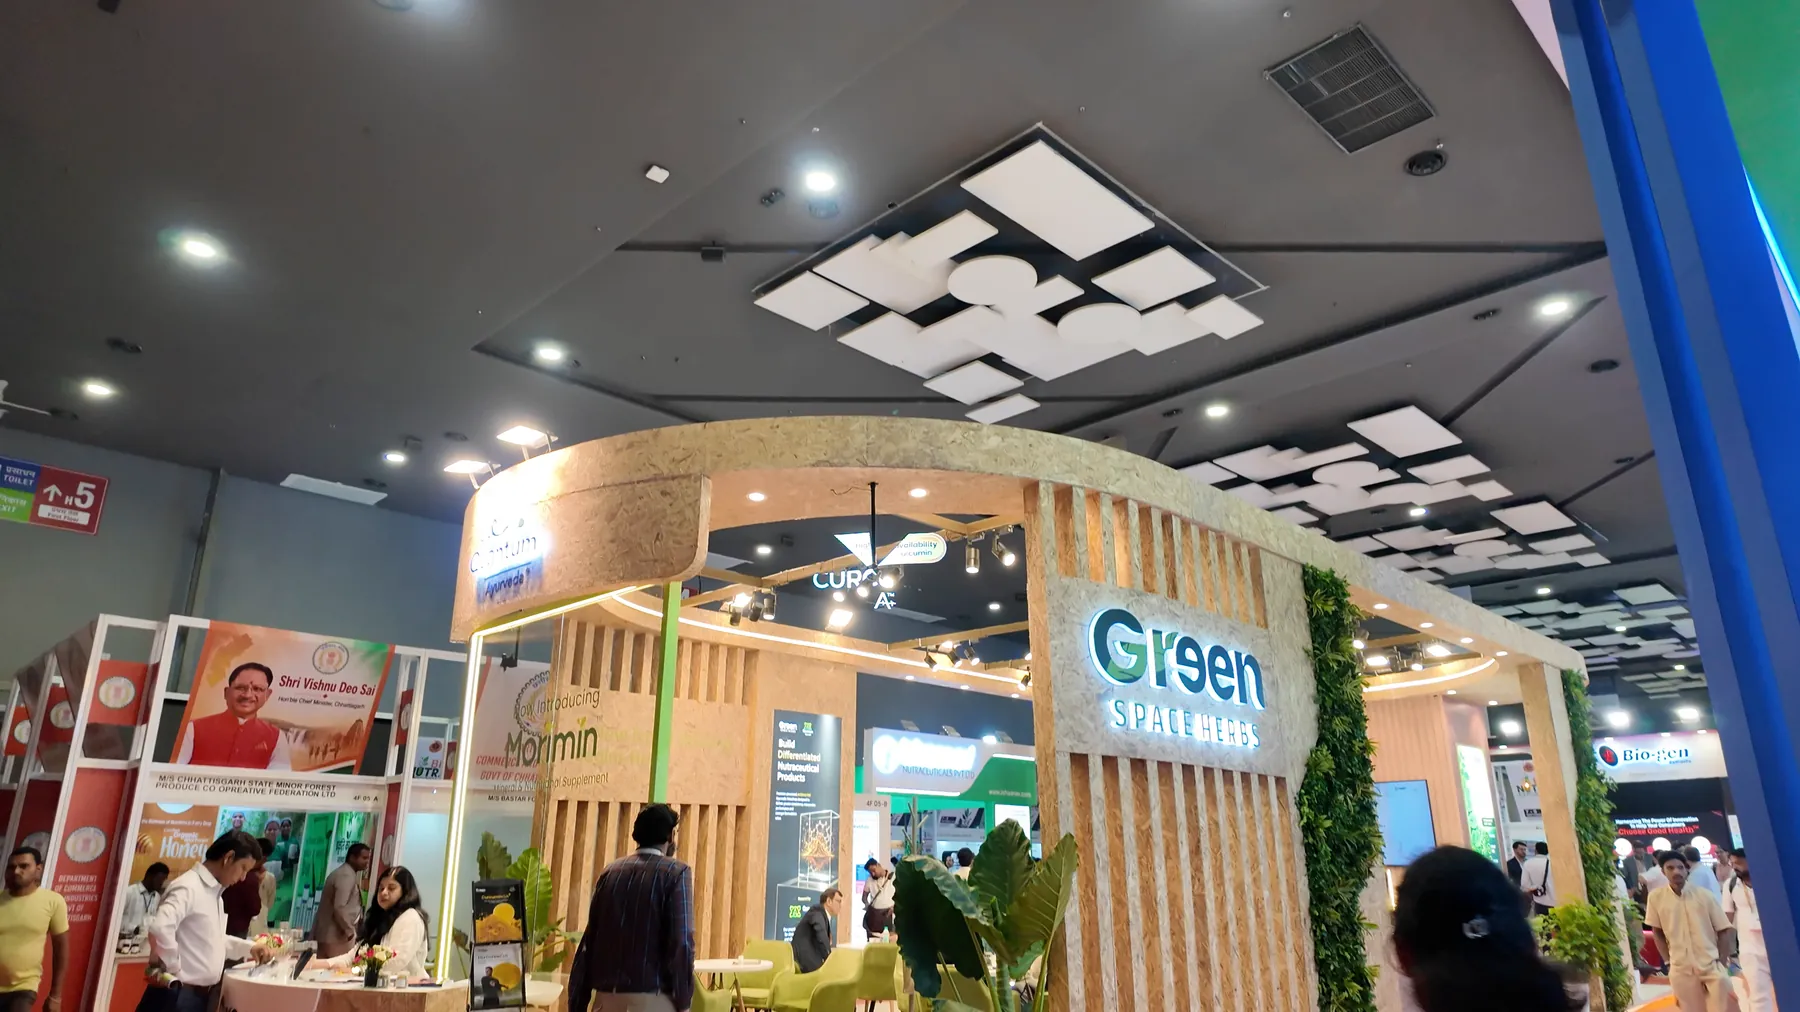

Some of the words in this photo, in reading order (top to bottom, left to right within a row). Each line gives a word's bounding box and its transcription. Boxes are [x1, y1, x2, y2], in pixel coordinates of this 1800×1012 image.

[4, 474, 34, 486] TOILET
[1089, 608, 1266, 710] Green
[279, 675, 301, 689] Shri
[303, 677, 337, 692] Vishnu
[339, 681, 358, 694] Deo
[360, 684, 376, 696] Sai
[299, 697, 313, 705] Chief
[537, 688, 600, 714] Introducing
[1110, 699, 1194, 738] SPACE
[1195, 713, 1261, 750] HERBS
[778, 738, 796, 749] Build
[777, 749, 821, 762] Differentiated
[1623, 748, 1689, 763] Bio-gen
[777, 760, 820, 773] Nutraceutical
[902, 765, 953, 777] NUTRACEUTICALS
[954, 769, 965, 778] PVT
[965, 770, 975, 779] LTD
[480, 771, 502, 781] GOVT
[503, 772, 514, 781] OF
[562, 773, 609, 789] Supplement
[777, 771, 806, 783] Products
[158, 775, 175, 783] M/S
[177, 775, 246, 786] CHHATTISGARH
[248, 779, 273, 788] STATE
[276, 780, 303, 789] MINOR
[304, 783, 337, 791] FOREST
[156, 782, 200, 792] PRODUCE
[202, 784, 216, 793] CO
[218, 784, 267, 796] OPREATIVE
[269, 788, 319, 798] FEDERATION
[321, 790, 337, 798] LTD
[1618, 827, 1647, 836] Choose
[1647, 827, 1668, 835] Good
[159, 836, 208, 864] Honey
[58, 874, 98, 883] DEPARTMENT
[54, 884, 63, 893] OF
[63, 884, 97, 893] COMMERCE
